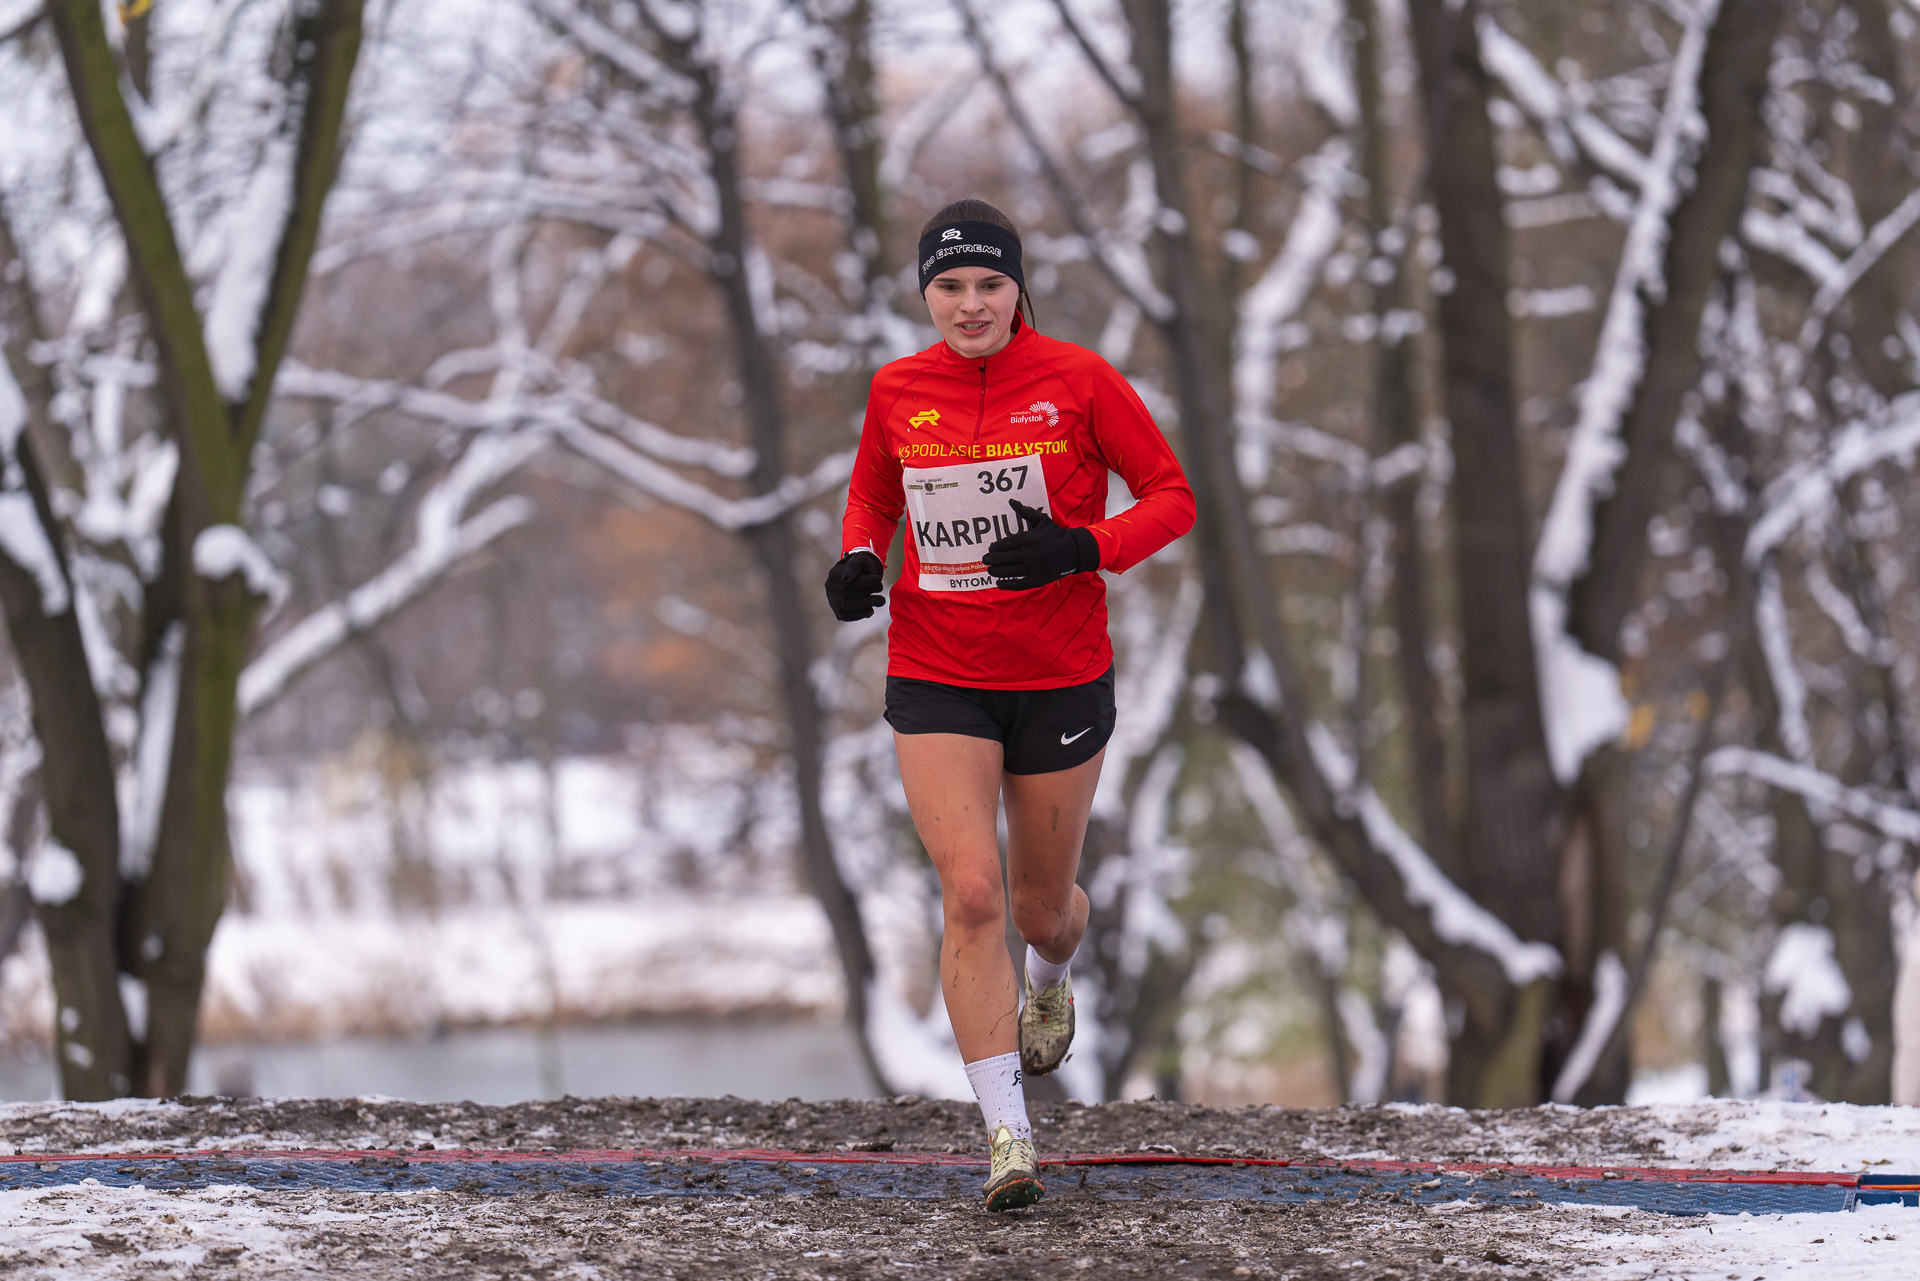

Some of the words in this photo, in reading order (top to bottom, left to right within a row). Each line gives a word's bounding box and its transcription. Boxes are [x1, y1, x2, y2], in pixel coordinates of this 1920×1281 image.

[936, 244, 1002, 260] EXTREME
[1010, 414, 1044, 424] Białystok
[898, 446, 910, 458] KS
[912, 444, 981, 459] PODLASIE
[986, 440, 1068, 457] BIAŁYSTOK
[977, 465, 1028, 494] 367
[916, 506, 1044, 548] KARPIU
[950, 576, 992, 588] BYTOM
